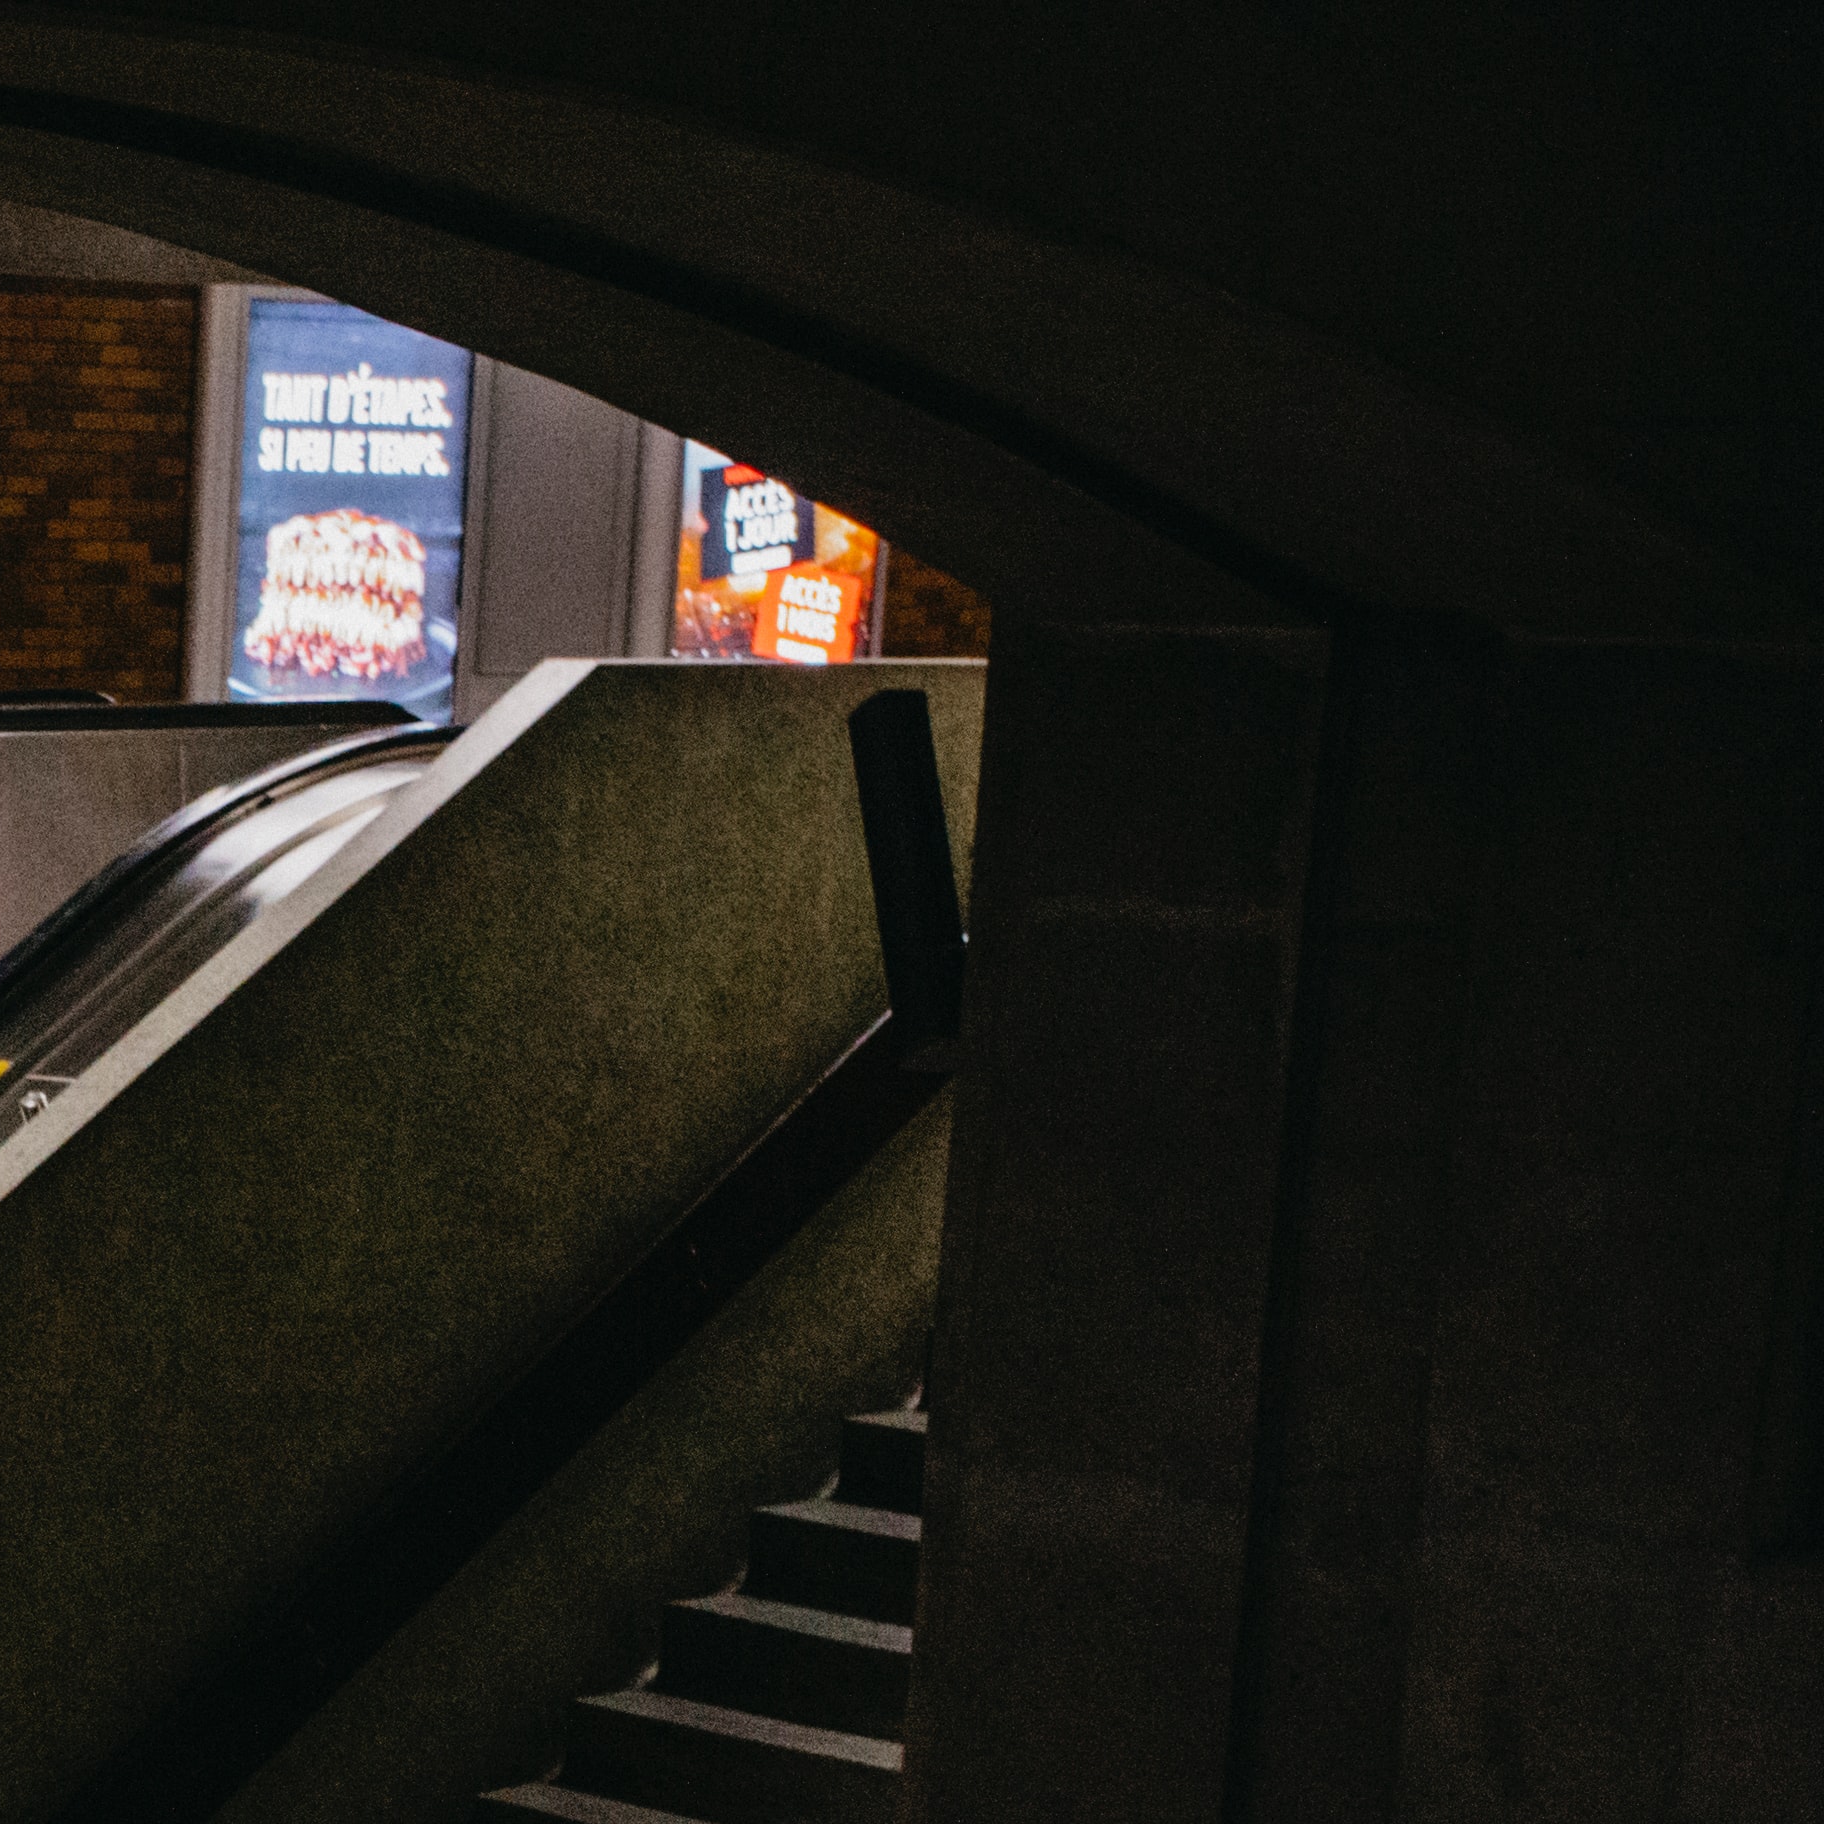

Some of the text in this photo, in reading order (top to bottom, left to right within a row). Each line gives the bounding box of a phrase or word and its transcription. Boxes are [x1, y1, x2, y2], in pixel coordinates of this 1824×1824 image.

[263, 373, 328, 422] TANT
[258, 428, 449, 477] SI PEU DE TEMPS.
[737, 512, 797, 550] JOUR
[781, 575, 842, 614] ACCÈS
[787, 606, 836, 643] MOIS
